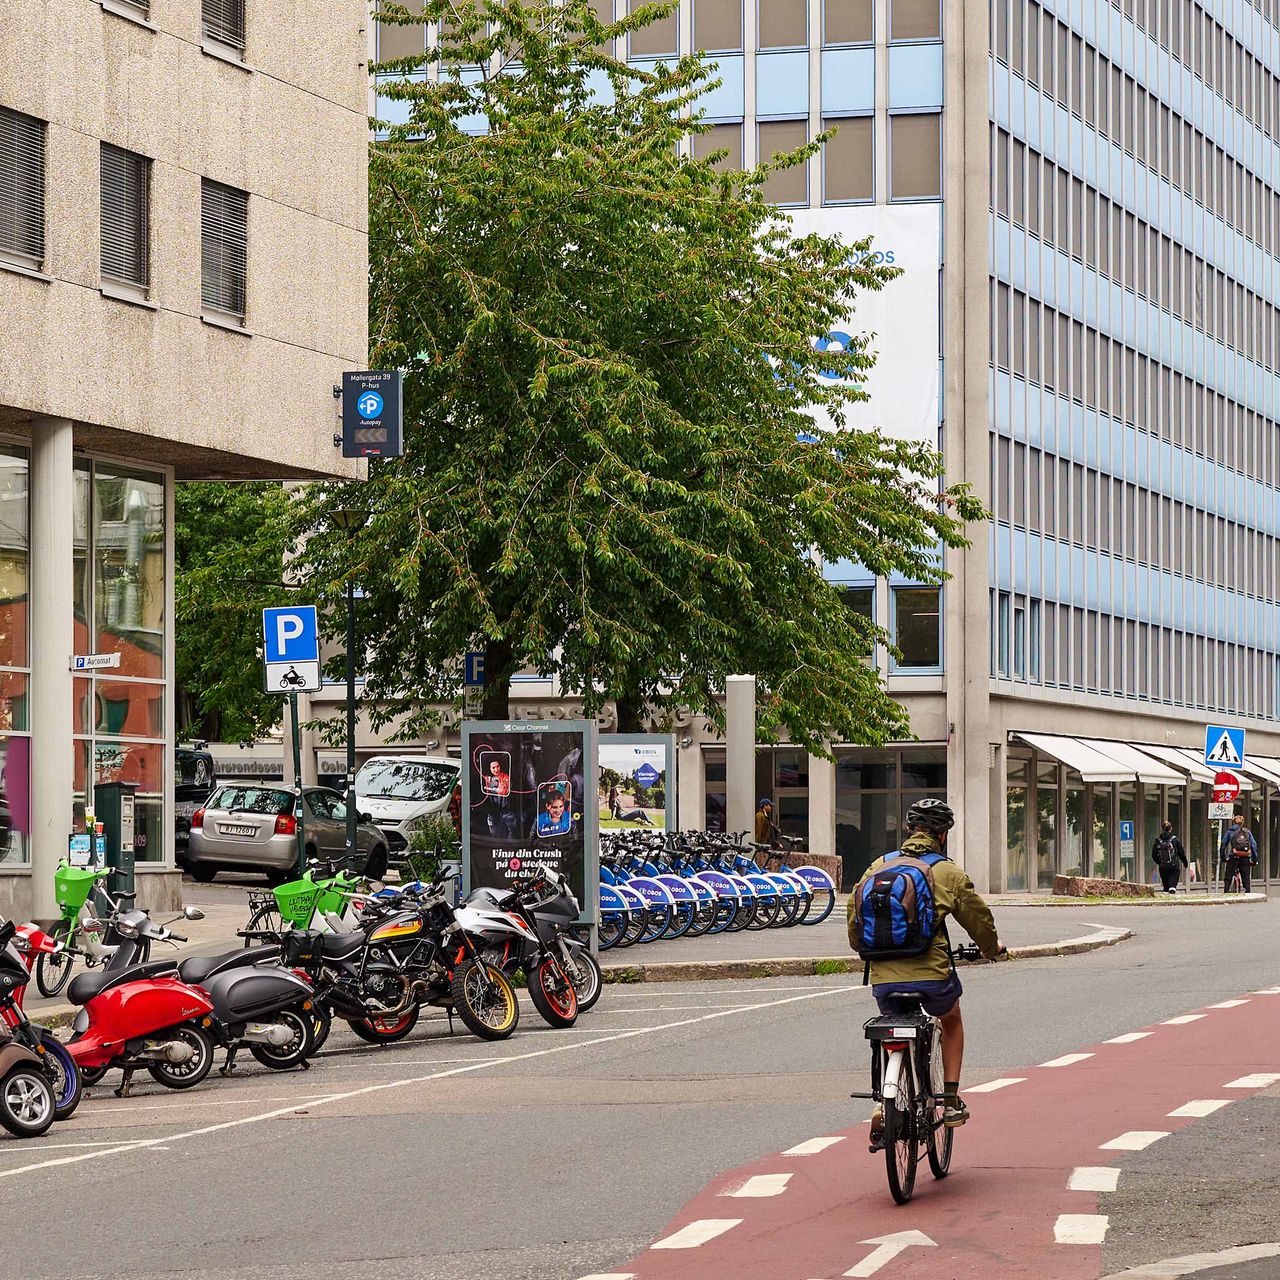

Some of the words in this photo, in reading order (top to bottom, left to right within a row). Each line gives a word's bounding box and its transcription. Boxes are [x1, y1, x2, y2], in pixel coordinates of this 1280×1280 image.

[366, 400, 378, 414] P
[276, 614, 304, 656] P
[78, 658, 84, 666] P
[492, 849, 514, 858] Finn
[516, 849, 532, 858] din
[533, 849, 562, 858] Crush
[496, 859, 508, 870] på
[504, 869, 518, 878] du
